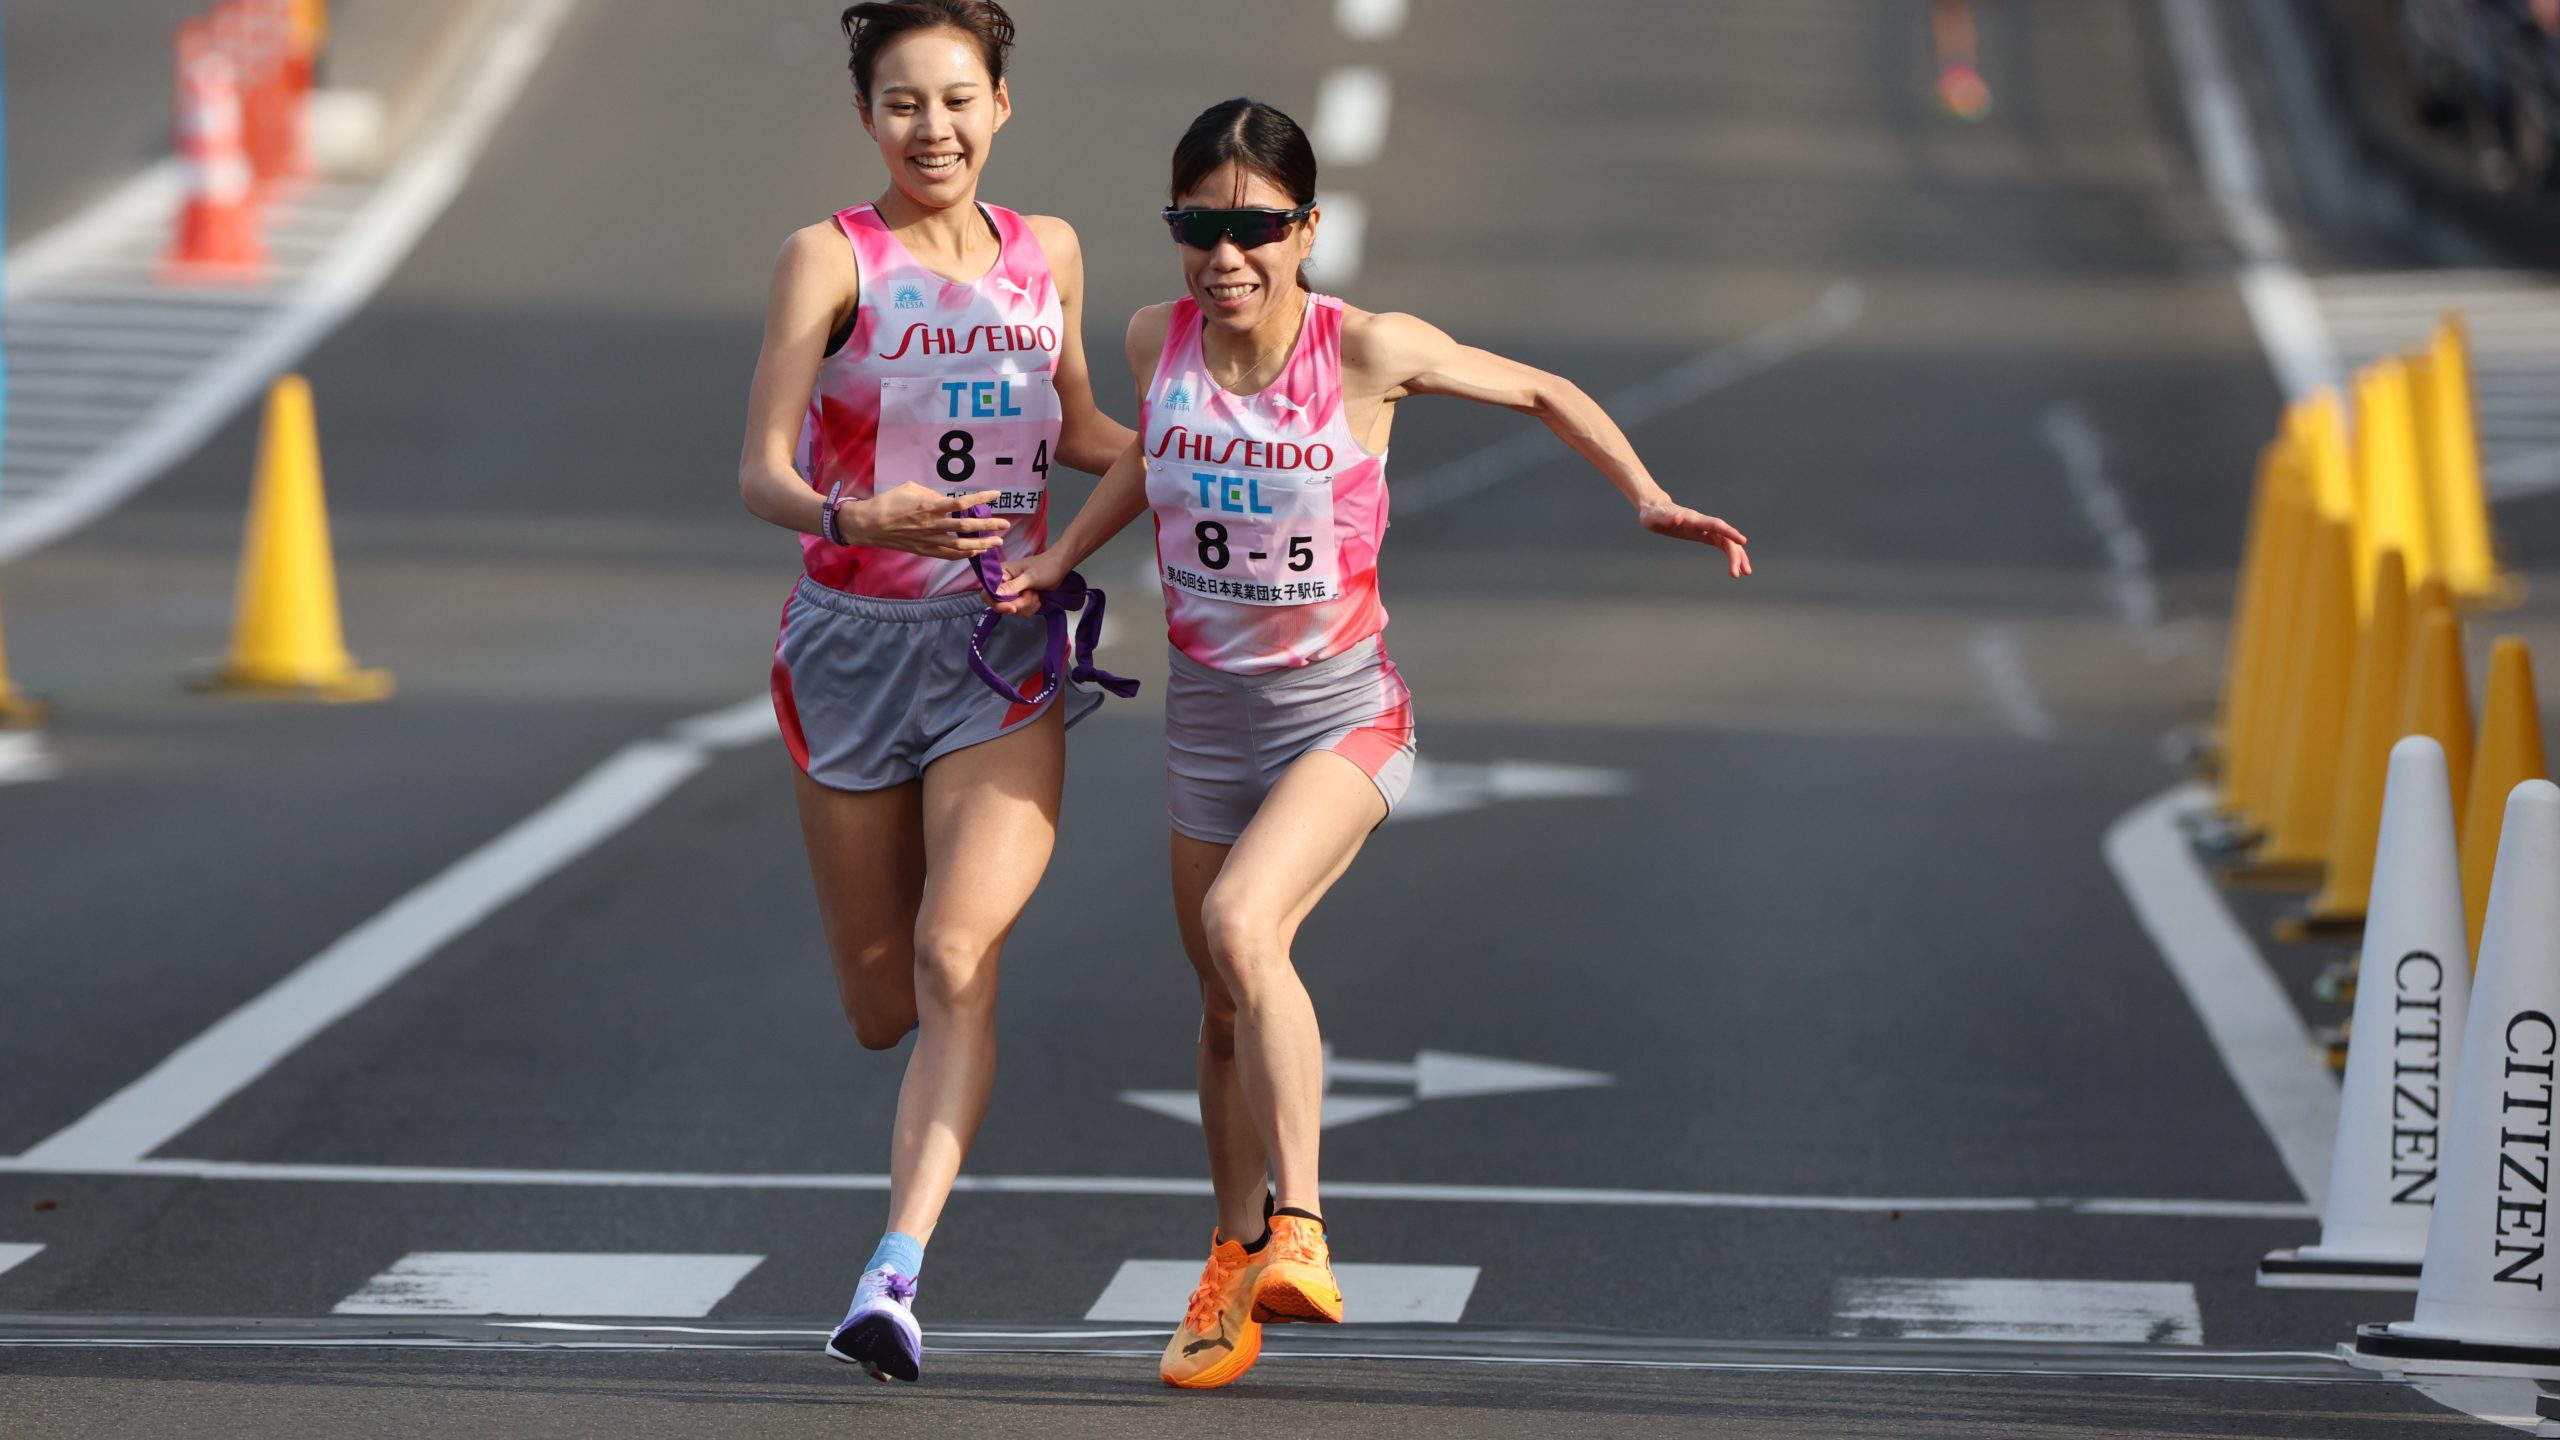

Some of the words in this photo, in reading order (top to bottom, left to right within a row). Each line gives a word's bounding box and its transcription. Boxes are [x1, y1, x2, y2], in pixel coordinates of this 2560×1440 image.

[894, 301, 925, 310] ANESSA
[879, 323, 1056, 360] SHISEIDO
[942, 381, 1021, 418] TEL
[936, 430, 976, 482] 8
[1032, 440, 1049, 480] 4
[1149, 425, 1334, 471] SHISEIDO
[1192, 472, 1273, 514] TEL
[1195, 521, 1230, 570] 8
[1288, 536, 1314, 572] 5
[1167, 566, 1326, 602] 第45回全日本実業団女子駅伝
[2391, 950, 2443, 1206] CITIZEN
[2493, 1010, 2557, 1291] CITIZEN
